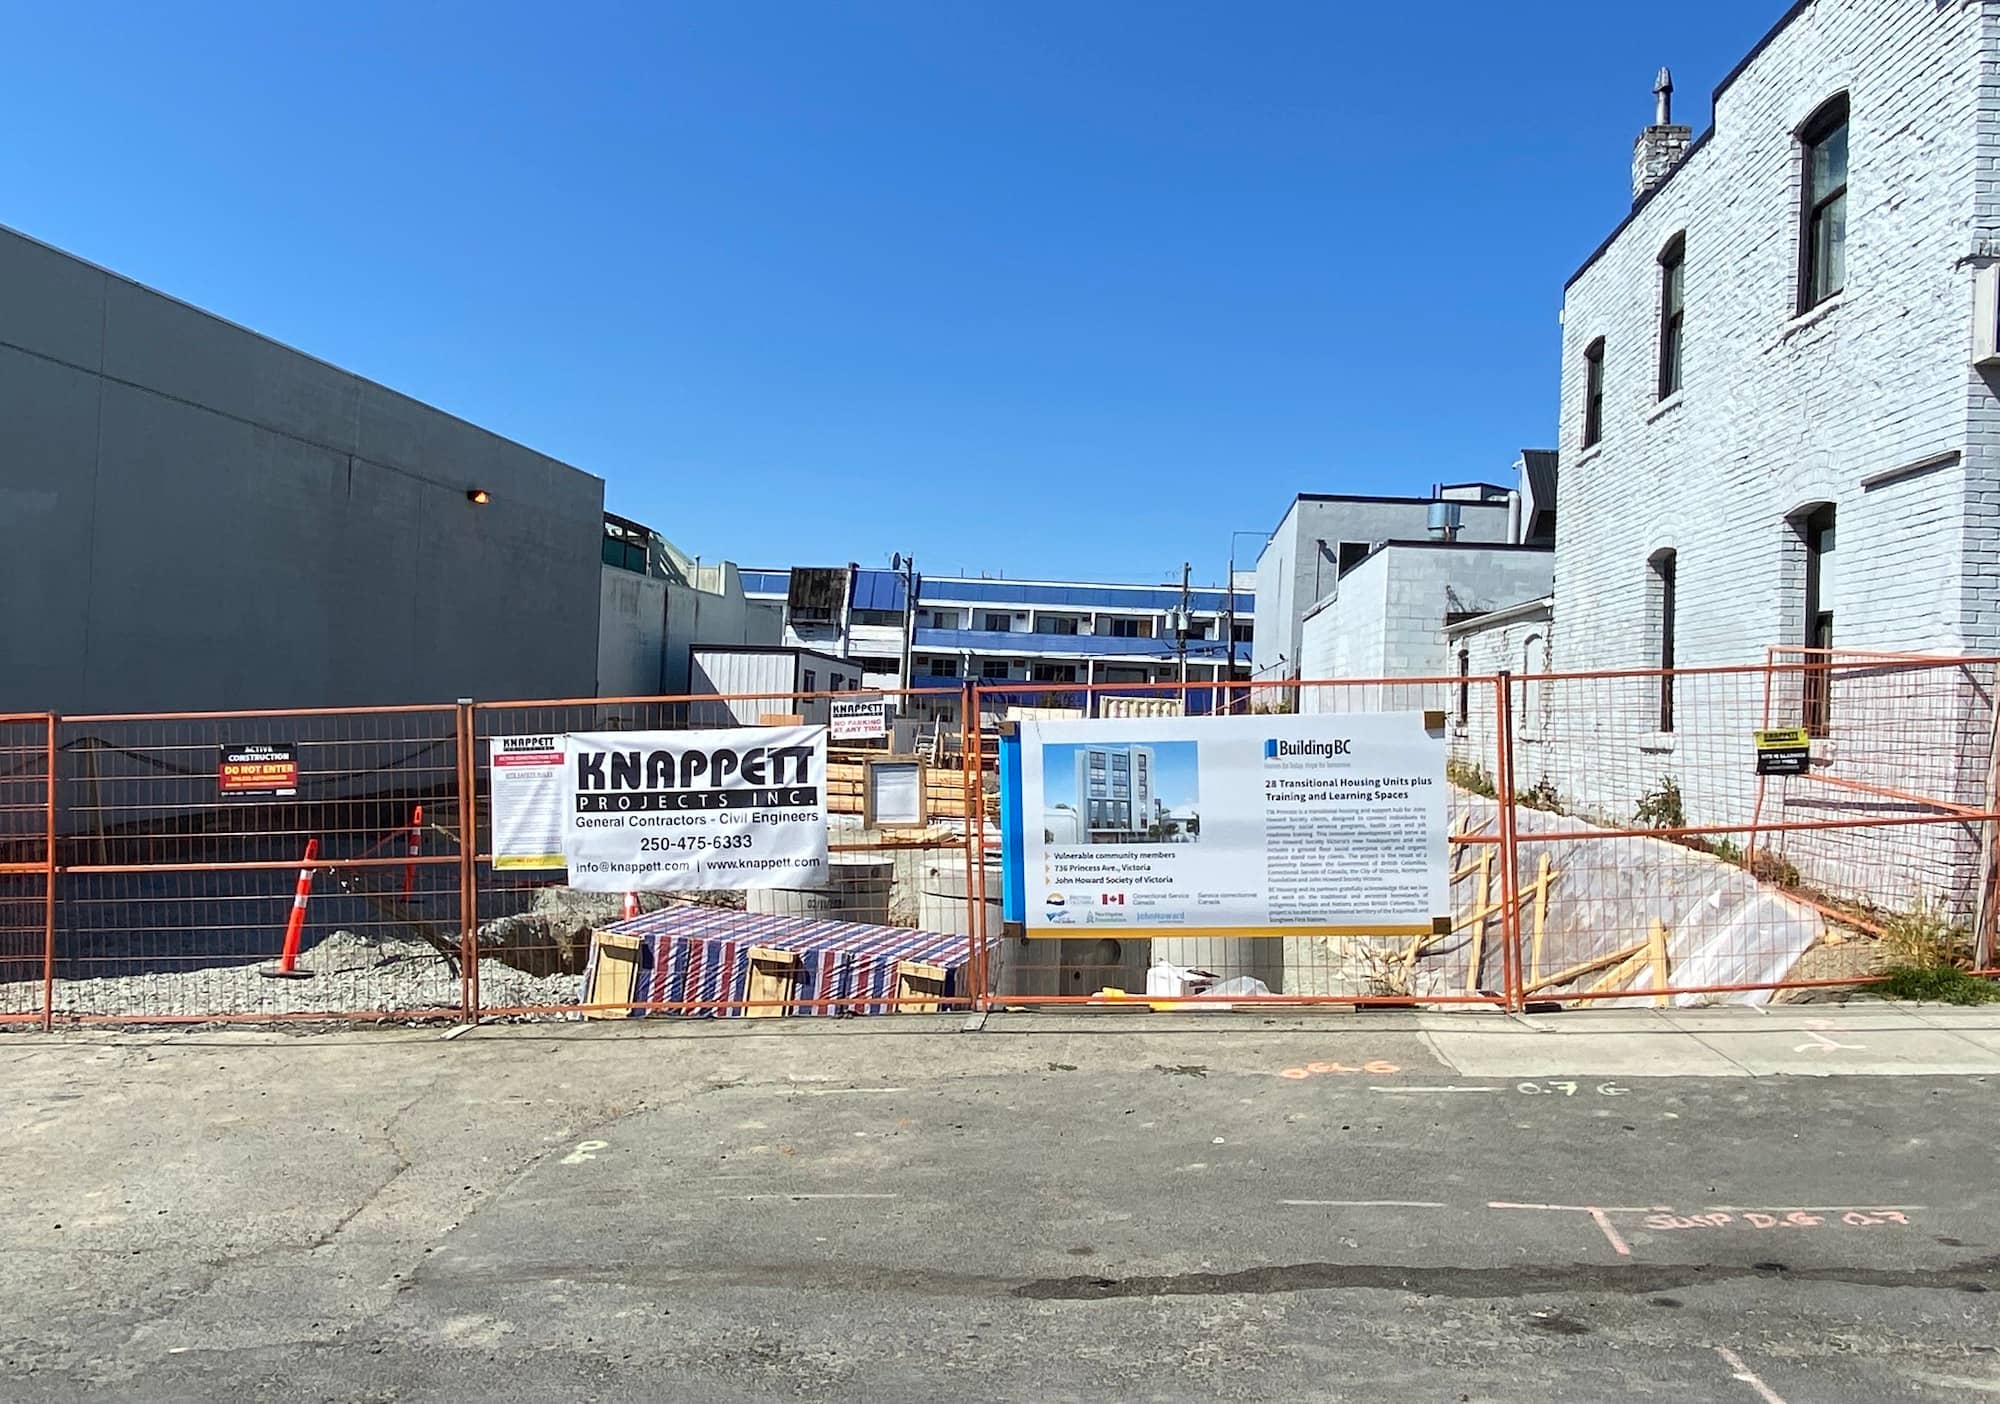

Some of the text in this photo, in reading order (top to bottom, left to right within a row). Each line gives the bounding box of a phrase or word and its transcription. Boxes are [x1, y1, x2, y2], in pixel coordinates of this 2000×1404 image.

[833, 704, 882, 713] KNAPPETT
[503, 737, 554, 747] KNAPPETT
[228, 753, 289, 762] CONSTRUCTION
[224, 764, 293, 775] DO NOT ENTER
[578, 746, 814, 790] KNAPPETT
[1265, 777, 1432, 788] 28 Transitional Housing Units plus
[580, 791, 814, 810] PROJECTS INC.
[1265, 791, 1408, 802] Training and Learning Spaces
[576, 816, 624, 827] General
[629, 815, 707, 827] Contractors
[720, 813, 747, 824] Civil
[752, 812, 819, 825] Engineers
[641, 834, 752, 851] 250-475-6333
[1095, 852, 1138, 860] community
[576, 861, 689, 874] info@knappett.com
[707, 858, 820, 870] www.knappett.com
[1106, 876, 1133, 885] Society
